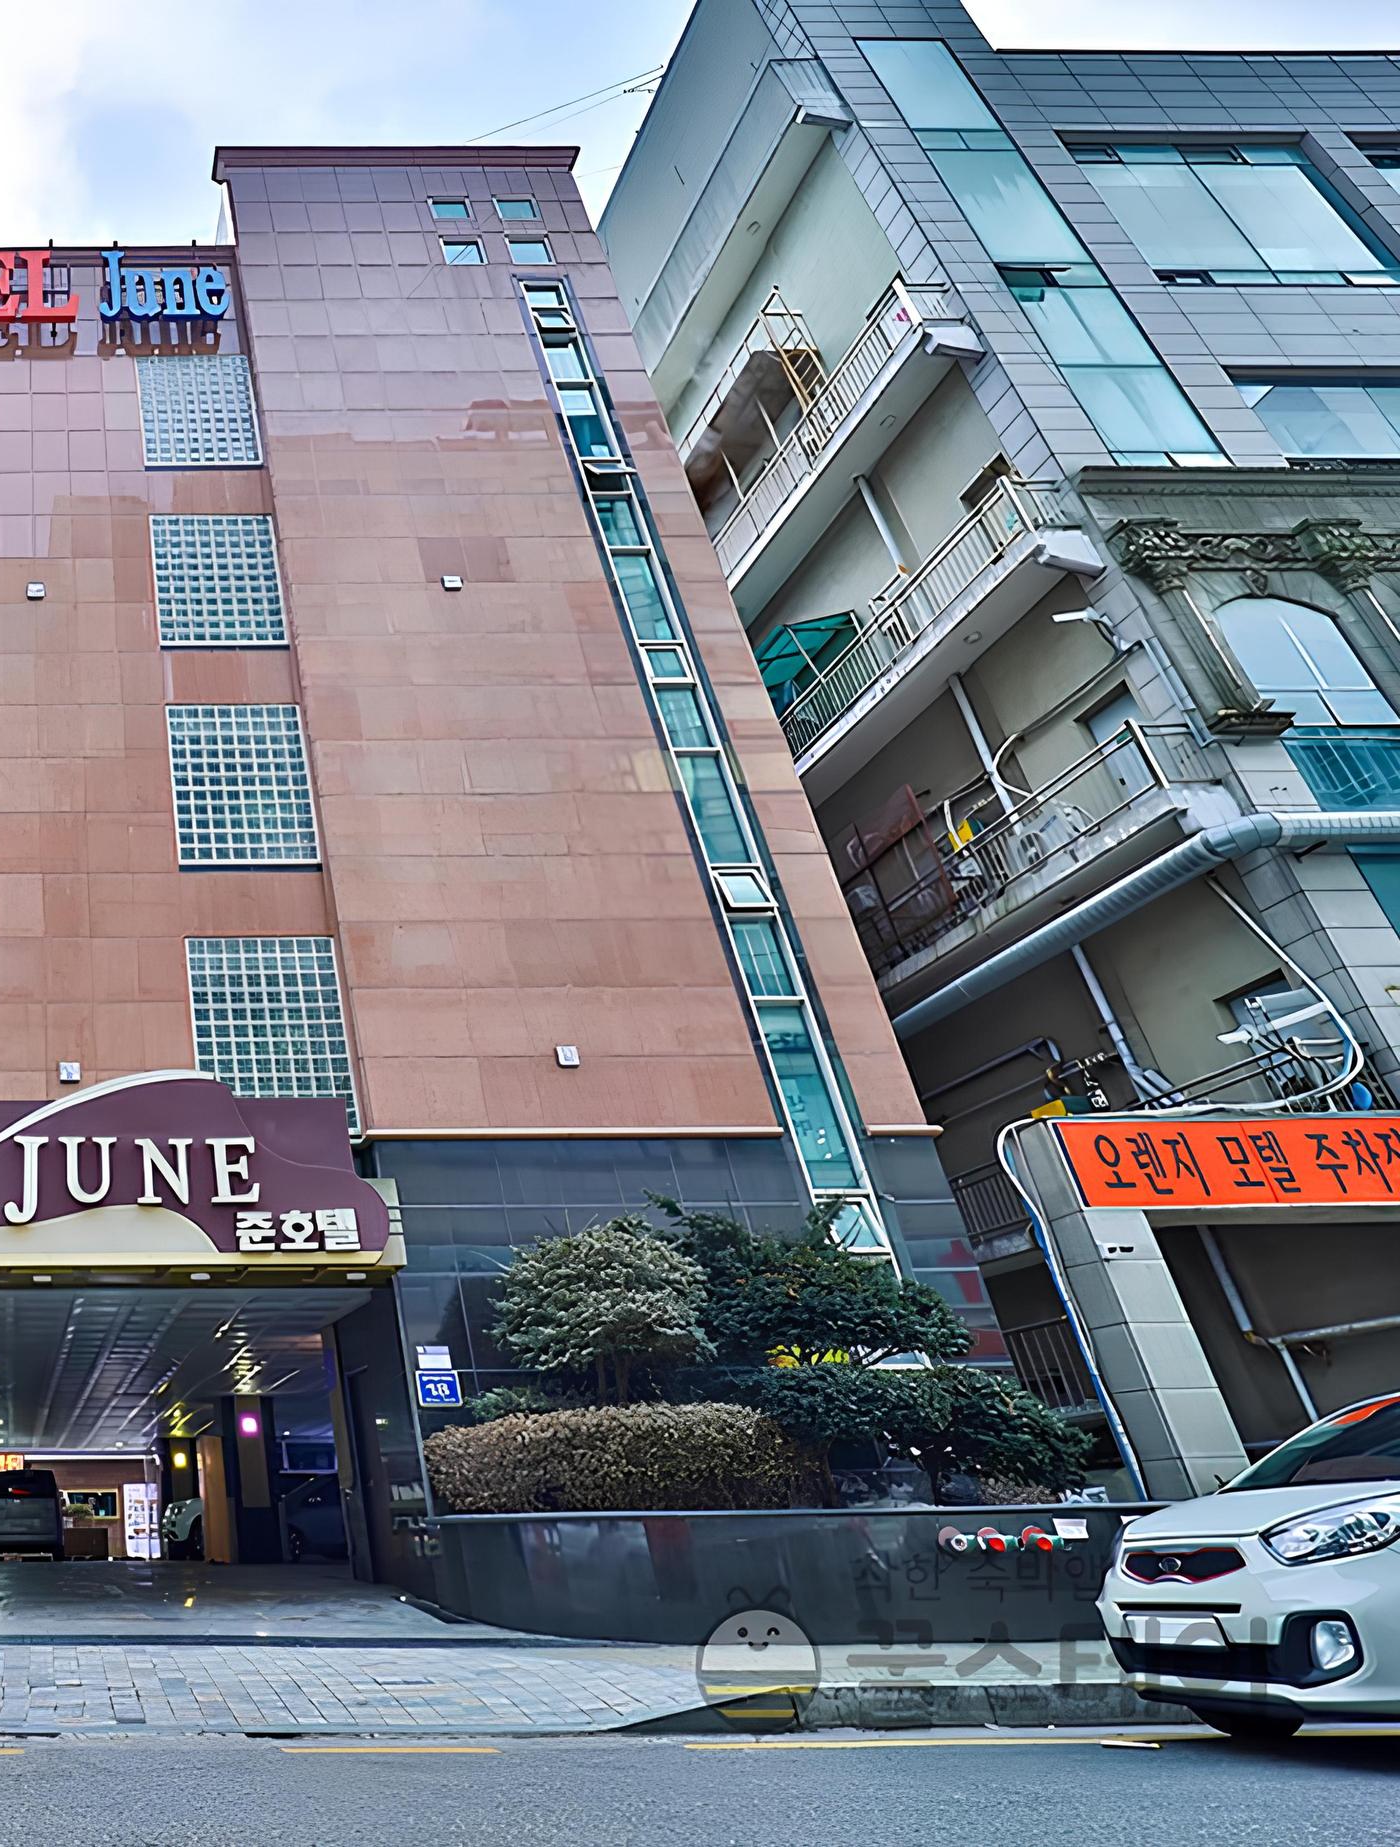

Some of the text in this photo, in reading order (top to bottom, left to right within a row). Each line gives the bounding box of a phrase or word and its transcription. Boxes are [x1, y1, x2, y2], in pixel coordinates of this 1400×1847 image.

[99, 249, 231, 322] June
[3, 1135, 261, 1225] JUNE
[1094, 1132, 1212, 1197] 오렌지
[1216, 1130, 1302, 1194] 모텔
[236, 1209, 362, 1253] 준호텔
